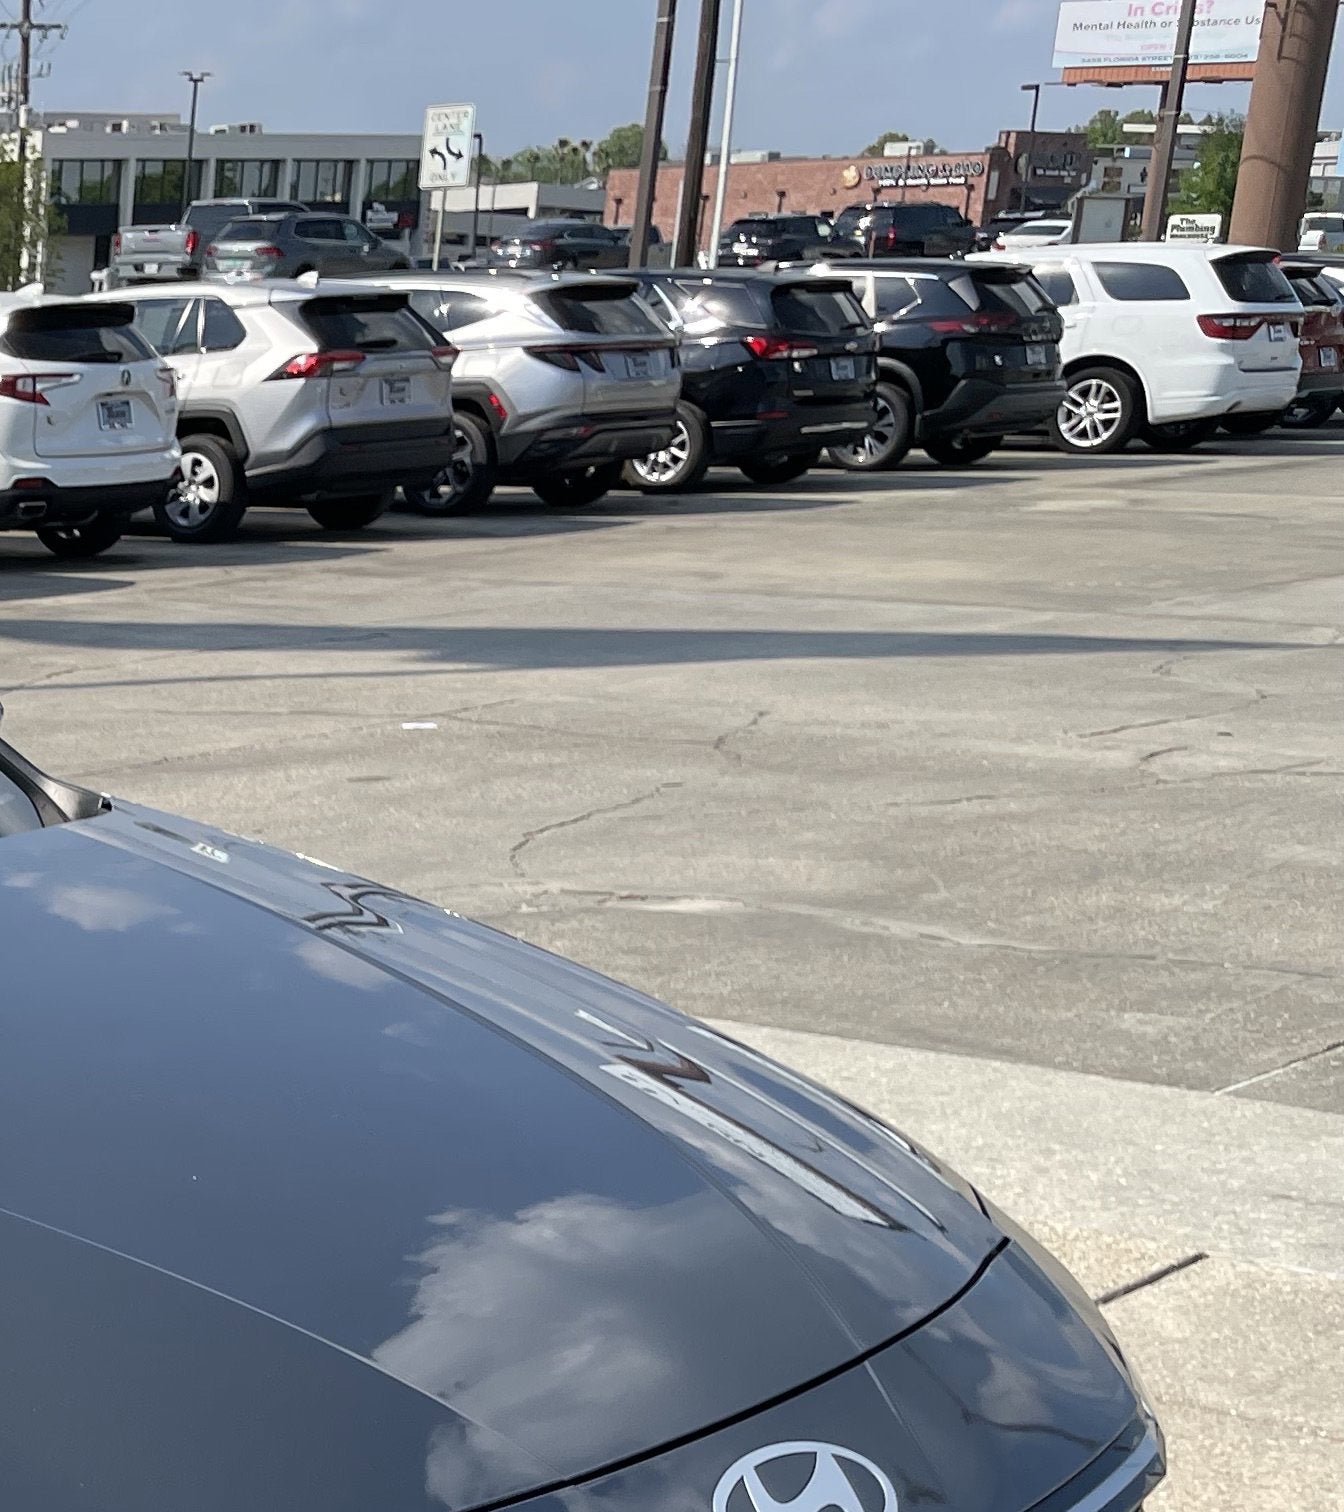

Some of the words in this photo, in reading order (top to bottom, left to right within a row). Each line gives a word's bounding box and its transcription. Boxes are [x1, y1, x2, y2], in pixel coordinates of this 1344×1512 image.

[1127, 4, 1144, 17] In
[1151, 0, 1213, 16] Cris?
[1072, 20, 1113, 31] Mental
[1117, 19, 1157, 30] Health
[1160, 20, 1172, 28] or
[1177, 17, 1241, 27] bstance
[1245, 16, 1262, 25] Us
[1172, 224, 1215, 235] Plumbing
